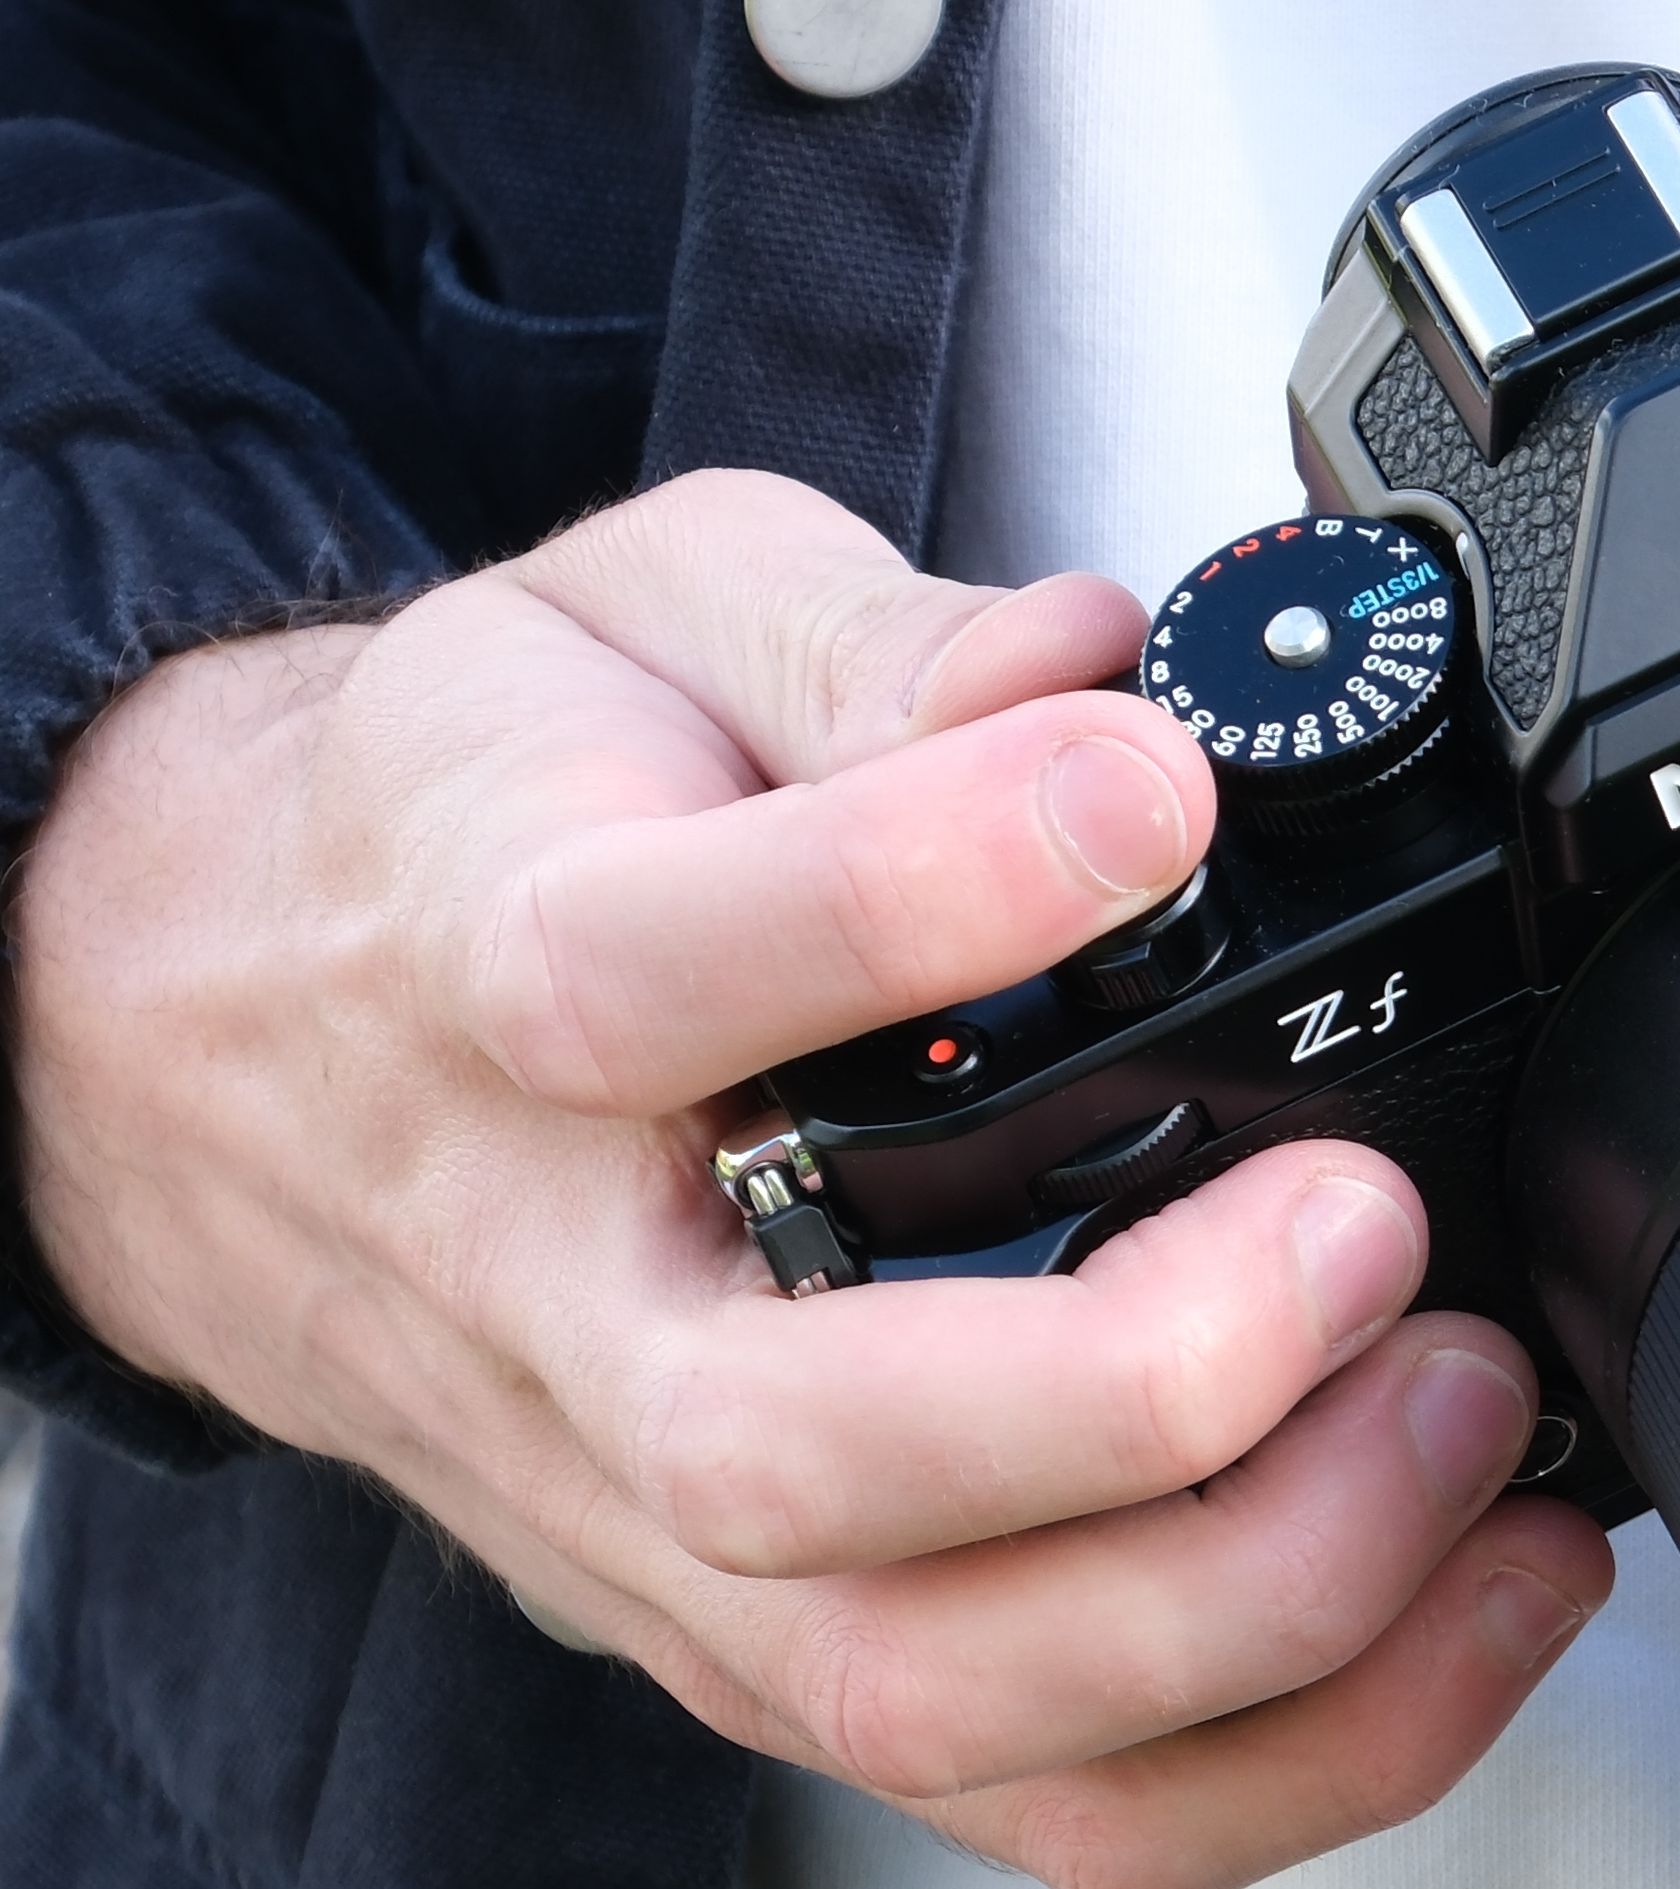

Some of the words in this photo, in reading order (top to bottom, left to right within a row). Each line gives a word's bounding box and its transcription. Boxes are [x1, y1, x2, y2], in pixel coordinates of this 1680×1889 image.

[1275, 525, 1302, 543] 4
[1315, 519, 1343, 537] B
[1355, 526, 1383, 544] T
[1232, 538, 1261, 558] 2
[1199, 561, 1222, 582] 1
[1169, 591, 1193, 614] 2
[1372, 597, 1448, 628] 8000
[1152, 625, 1173, 649] 4
[1369, 632, 1445, 656] 4000
[1150, 660, 1170, 684] 8
[1362, 654, 1430, 690] 2000
[1156, 685, 1194, 715] 15
[1345, 675, 1399, 723] 1000
[1328, 700, 1365, 744] 500
[1212, 725, 1246, 756] 60
[1250, 722, 1285, 762] 125
[1293, 713, 1323, 758] 250
